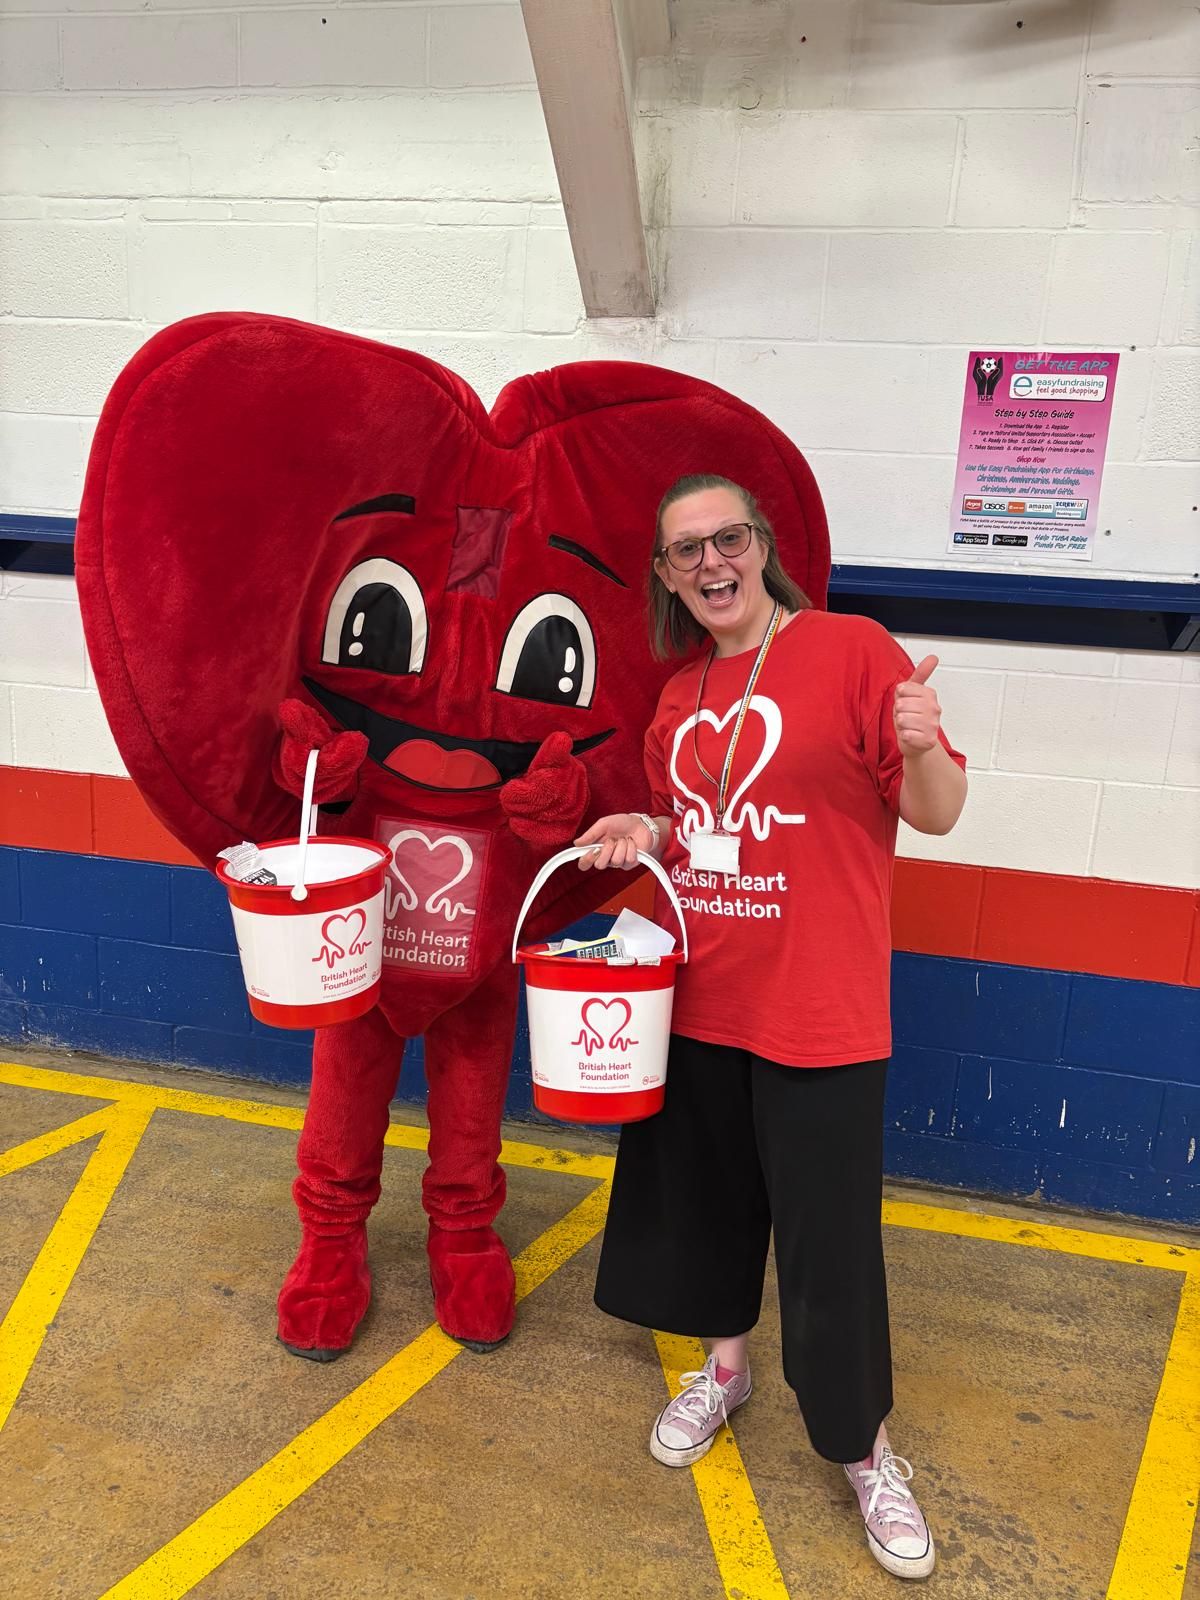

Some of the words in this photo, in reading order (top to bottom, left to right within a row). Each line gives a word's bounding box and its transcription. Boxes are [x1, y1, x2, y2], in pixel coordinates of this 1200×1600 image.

[1014, 360, 1045, 371] GET
[1049, 360, 1077, 371] THE
[1078, 361, 1110, 372] APP
[1036, 378, 1105, 388] easyfundraising
[1036, 386, 1049, 394] feel
[1051, 387, 1067, 395] good
[1069, 387, 1099, 396] shopping
[995, 408, 1014, 418] Step
[1016, 409, 1027, 419] by
[1029, 410, 1048, 419] Step
[1050, 410, 1075, 419] Guide
[1016, 455, 1031, 464] Shop
[988, 465, 1003, 473] Easy
[1004, 465, 1038, 474] Fundraising
[980, 485, 1016, 494] Christenings
[1034, 534, 1049, 542] Help
[723, 871, 788, 892] Heart
[672, 889, 782, 919] oundation
[383, 923, 416, 944] itish
[420, 929, 469, 949] Heart
[383, 945, 466, 968] undation
[320, 970, 348, 983] British
[349, 962, 368, 977] Heart
[323, 973, 367, 992] Foundation
[578, 1061, 607, 1071] British
[608, 1061, 632, 1070] Heart
[580, 1072, 630, 1081] Foundation
